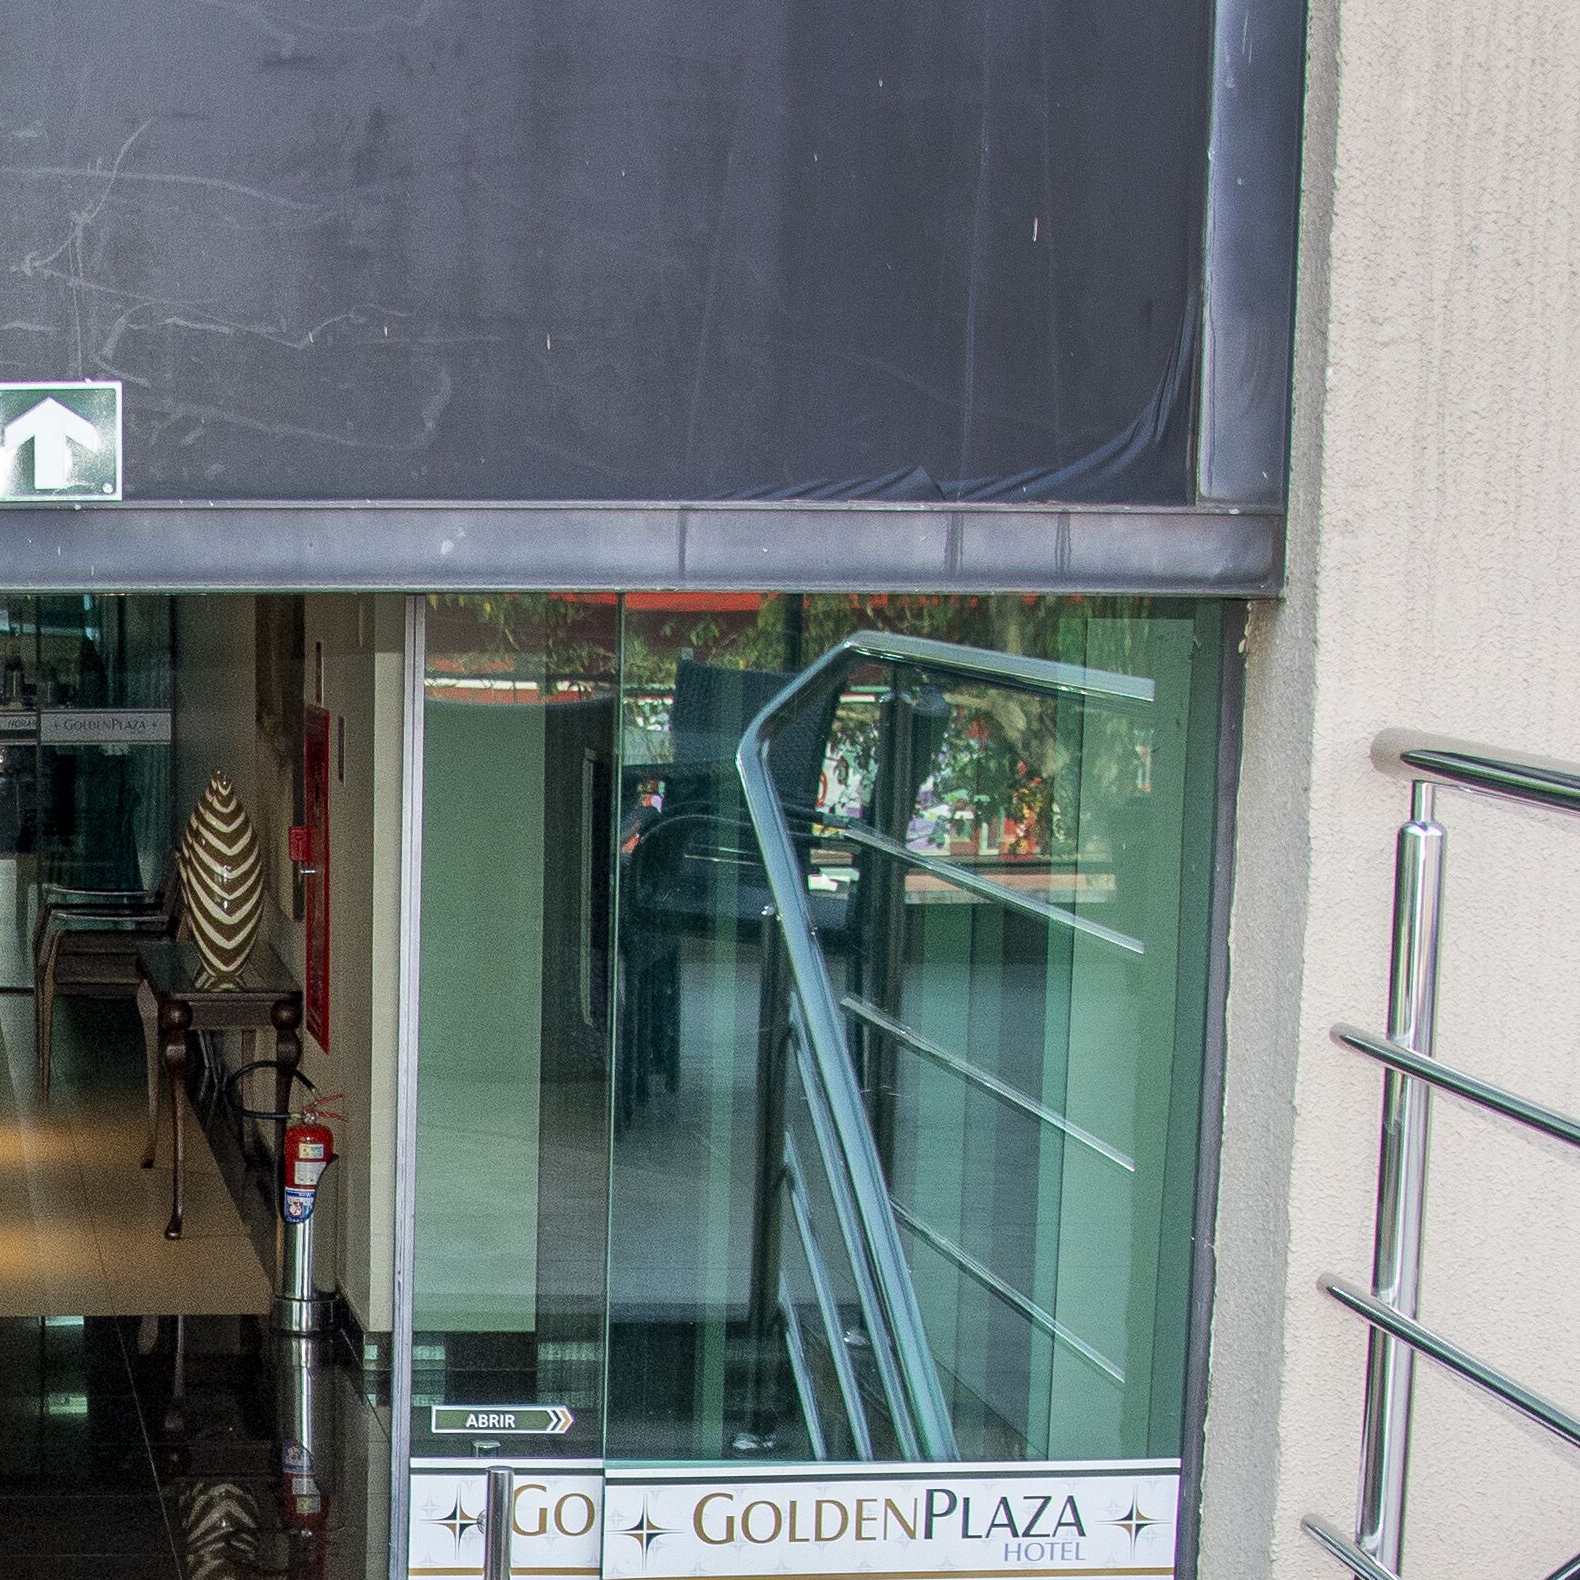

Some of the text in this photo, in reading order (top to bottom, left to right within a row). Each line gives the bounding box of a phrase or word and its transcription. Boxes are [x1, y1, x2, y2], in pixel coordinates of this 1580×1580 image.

[466, 1413, 516, 1428] ABRIR
[511, 1483, 596, 1537] GO
[1003, 1541, 1086, 1562] HOTEL
